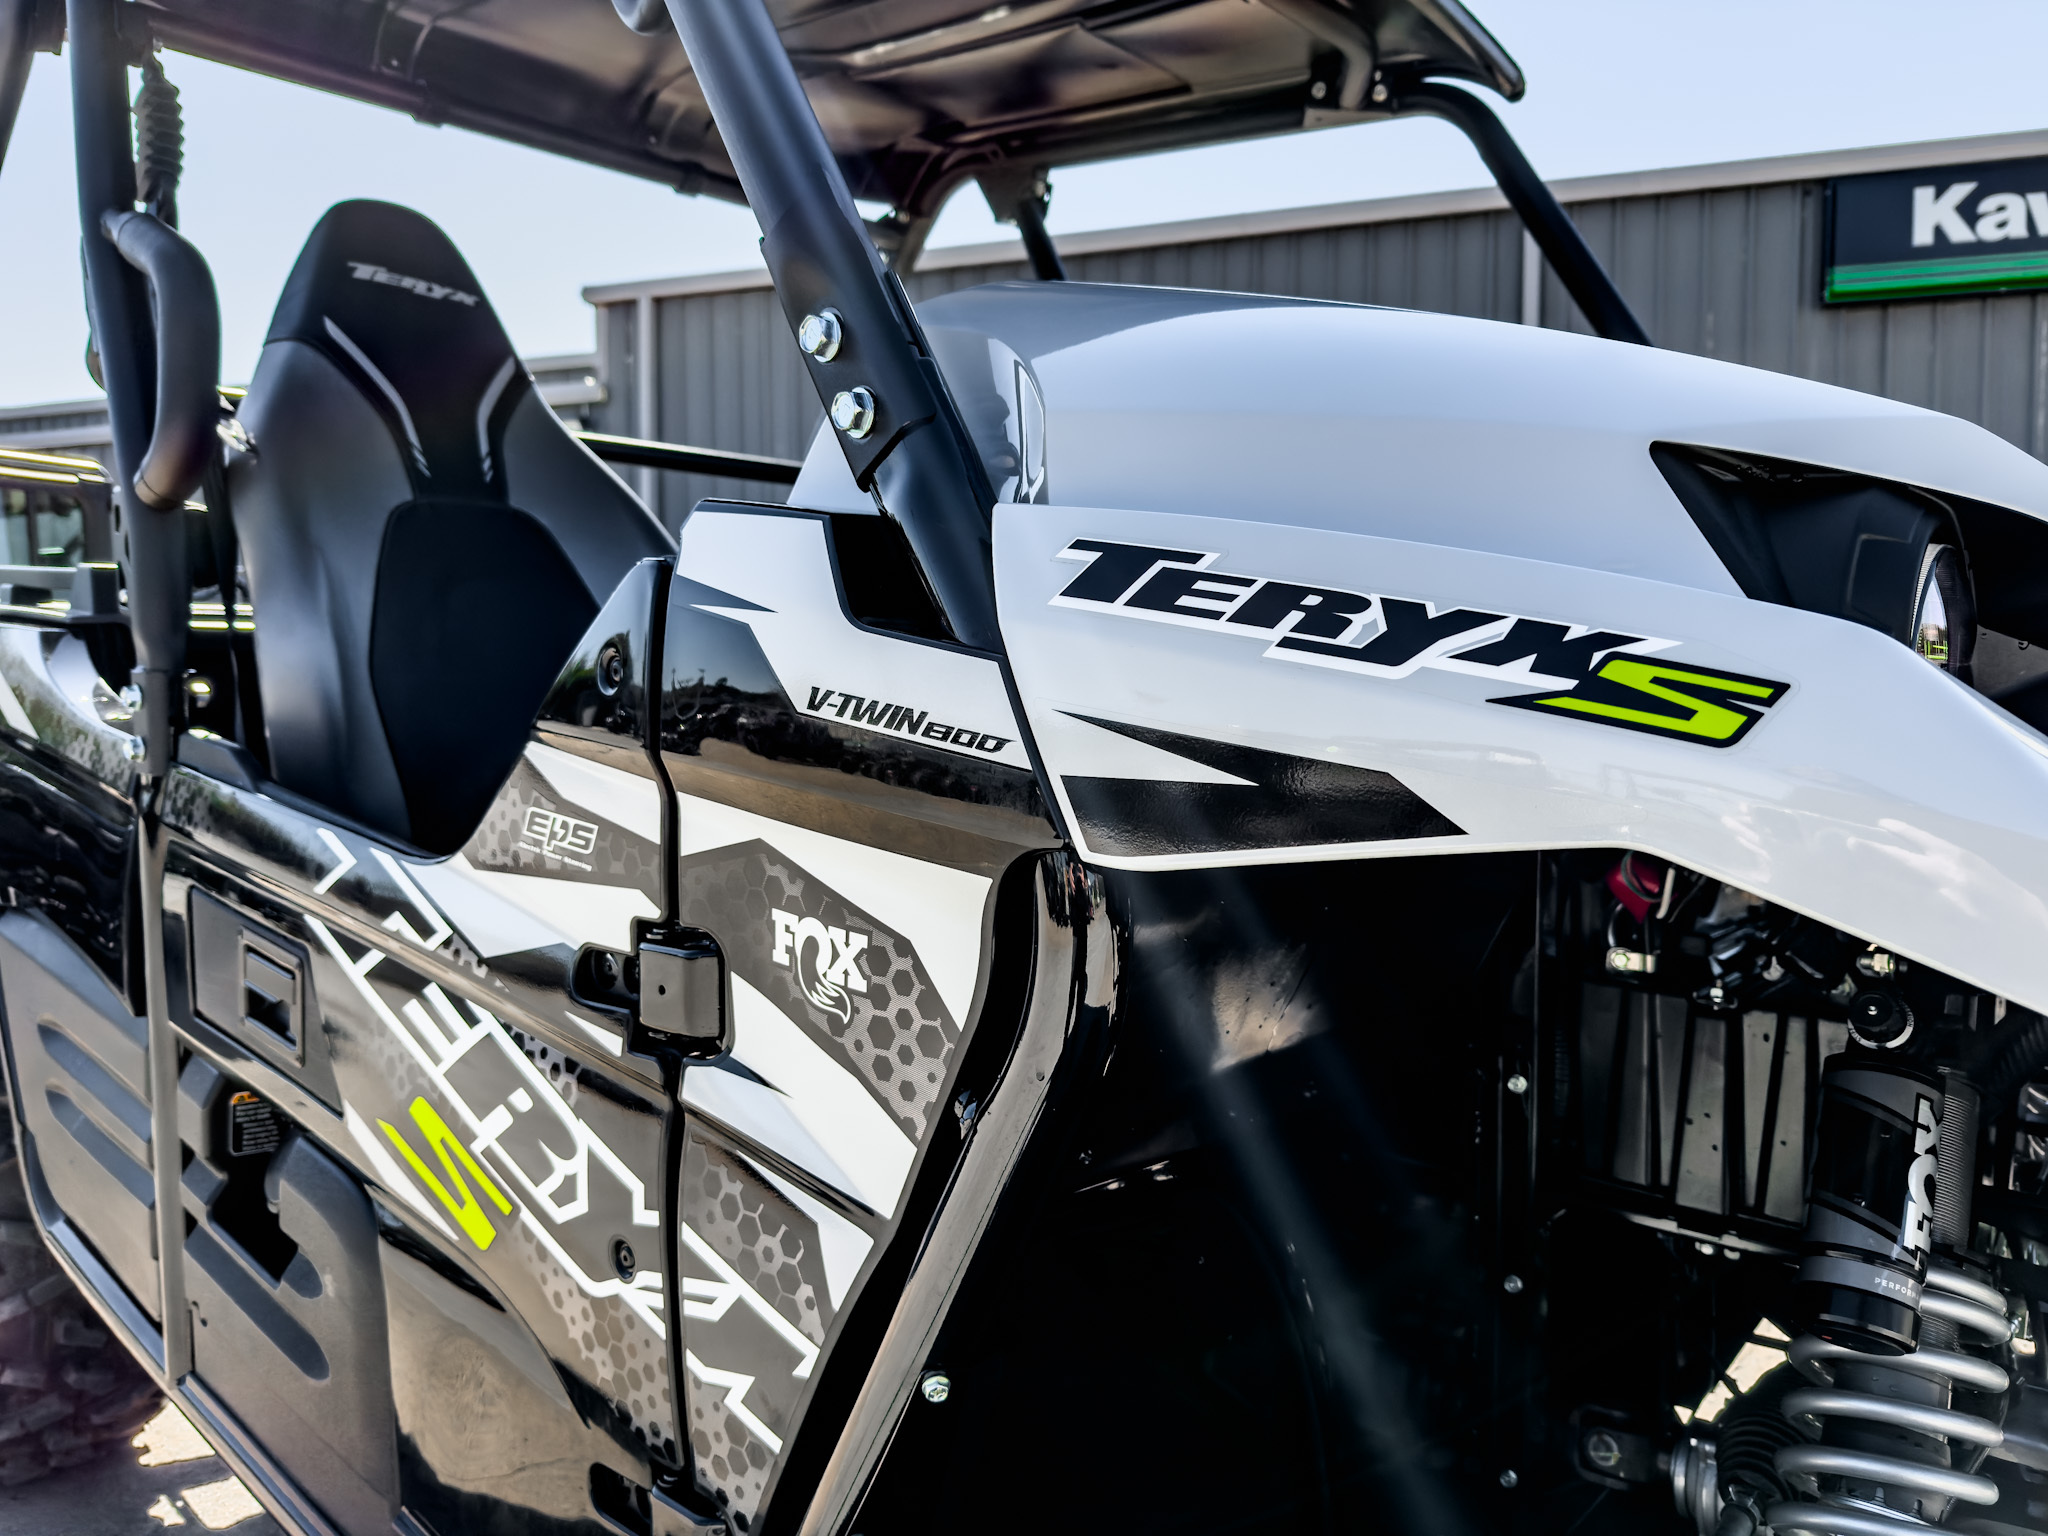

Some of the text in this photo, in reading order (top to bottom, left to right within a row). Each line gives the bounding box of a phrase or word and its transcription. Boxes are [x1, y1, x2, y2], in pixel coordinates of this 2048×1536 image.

[346, 261, 480, 307] TERYX
[806, 685, 1017, 754] V-TWIN 800
[523, 806, 599, 855] EPS
[771, 907, 869, 1024] FOX
